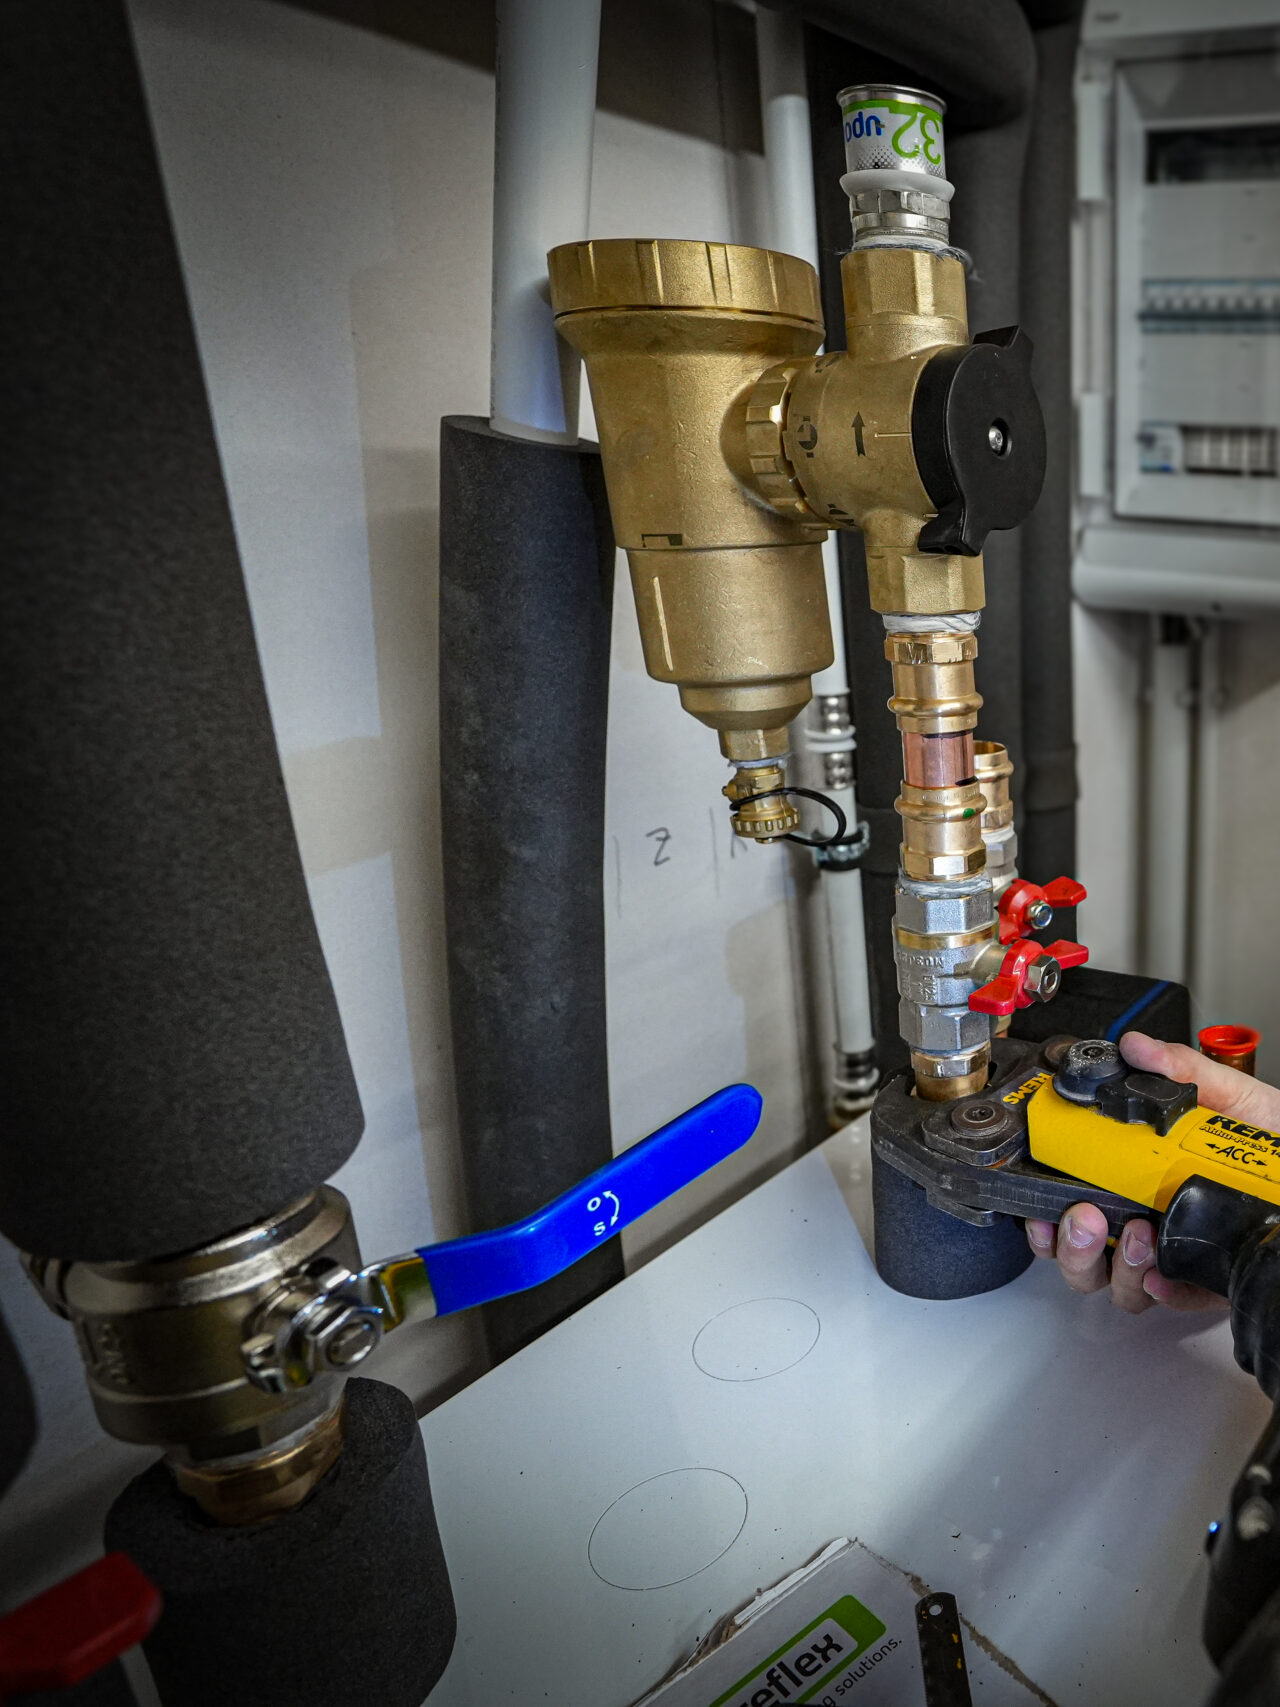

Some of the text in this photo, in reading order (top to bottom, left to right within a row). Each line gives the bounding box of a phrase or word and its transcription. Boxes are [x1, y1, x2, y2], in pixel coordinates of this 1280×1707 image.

[889, 106, 942, 165] 32
[1215, 1145, 1255, 1164] ACC
[593, 1221, 606, 1236] S
[739, 1633, 844, 1707] eflex
[835, 1638, 903, 1696] solutions.
